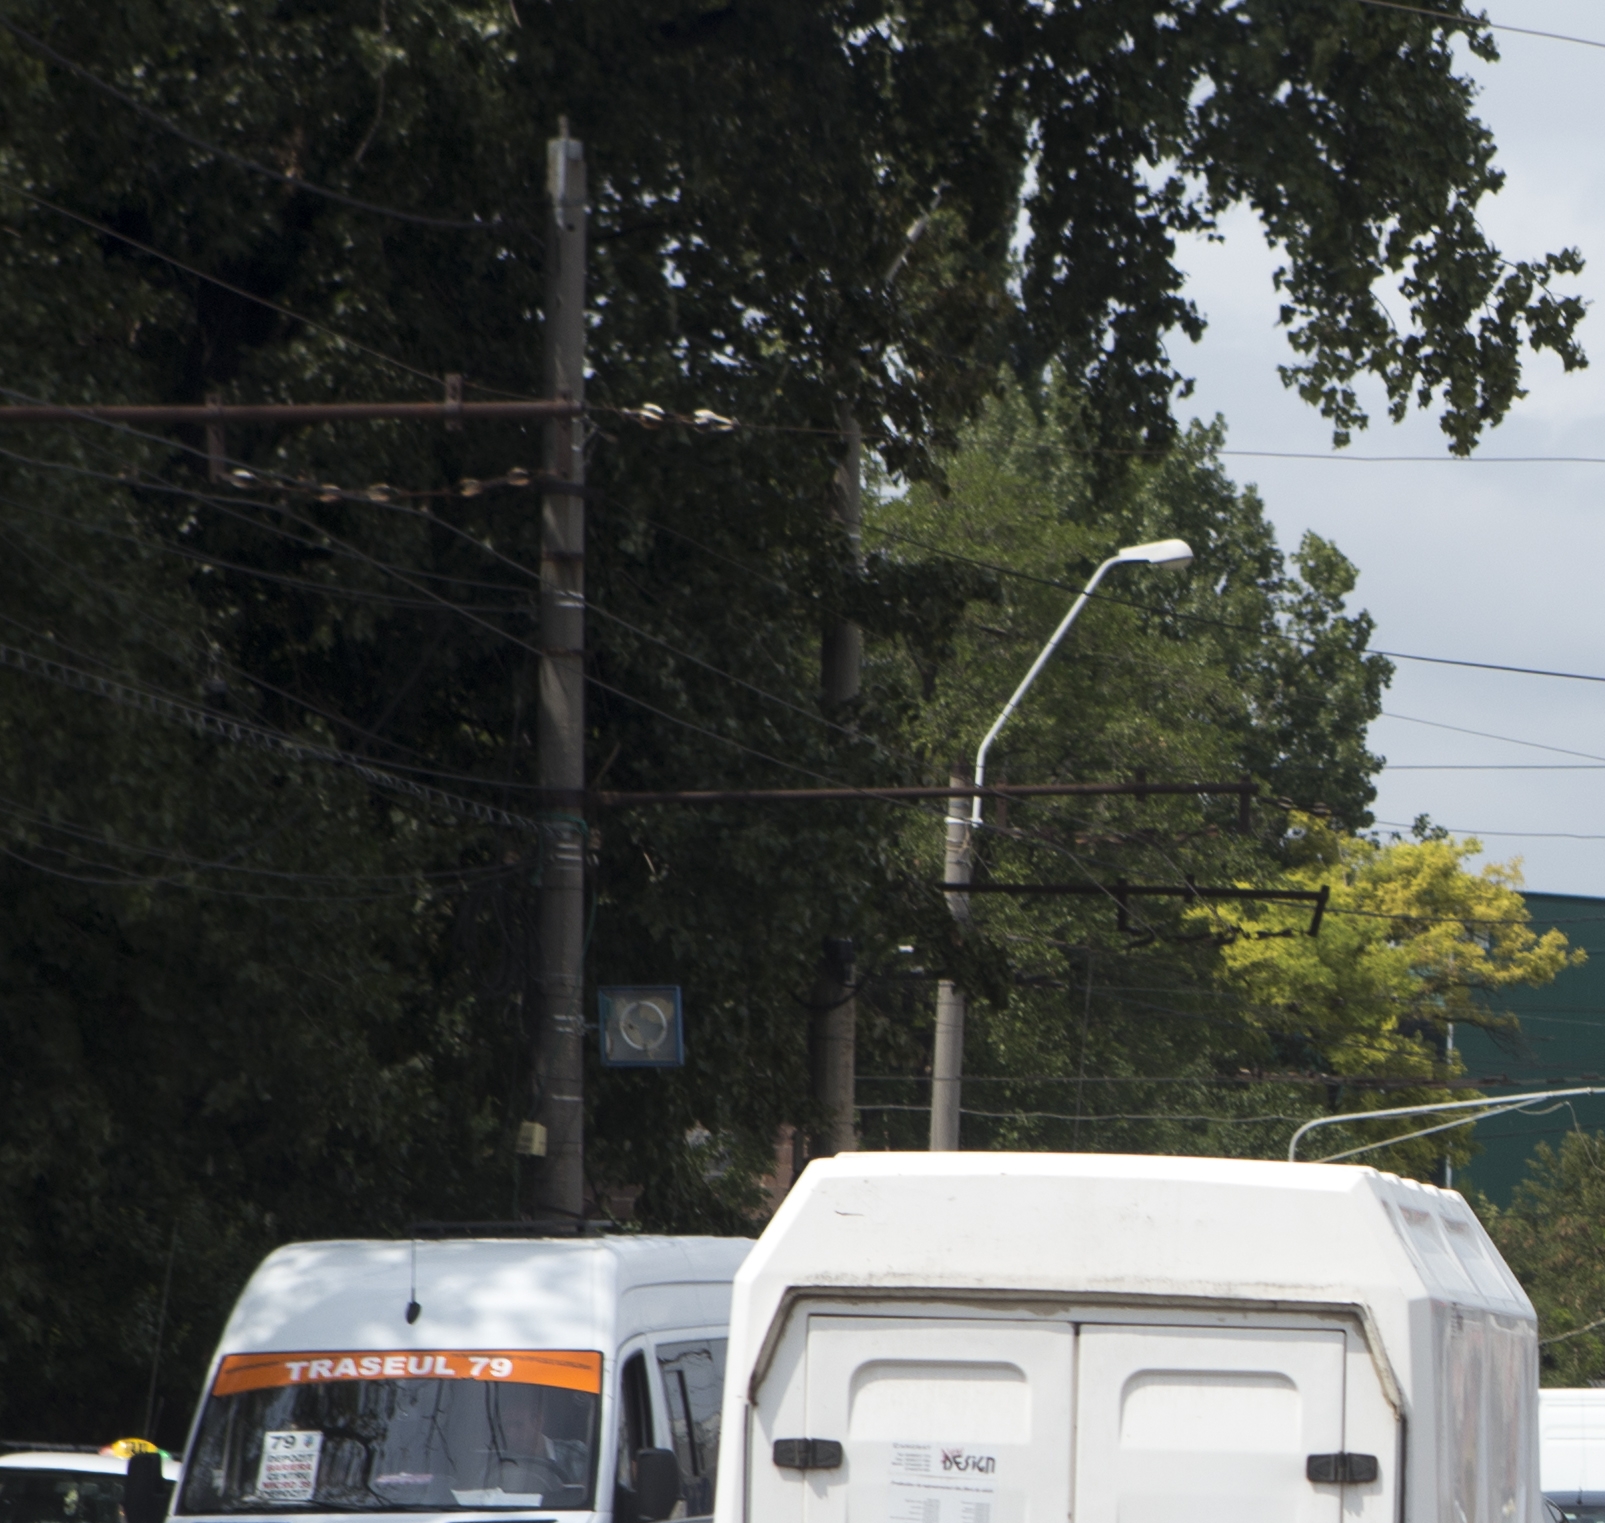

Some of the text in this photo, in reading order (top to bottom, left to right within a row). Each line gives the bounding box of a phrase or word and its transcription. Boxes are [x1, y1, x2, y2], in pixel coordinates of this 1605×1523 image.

[284, 1355, 514, 1381] TRASEUL 79
[269, 1435, 296, 1450] 79
